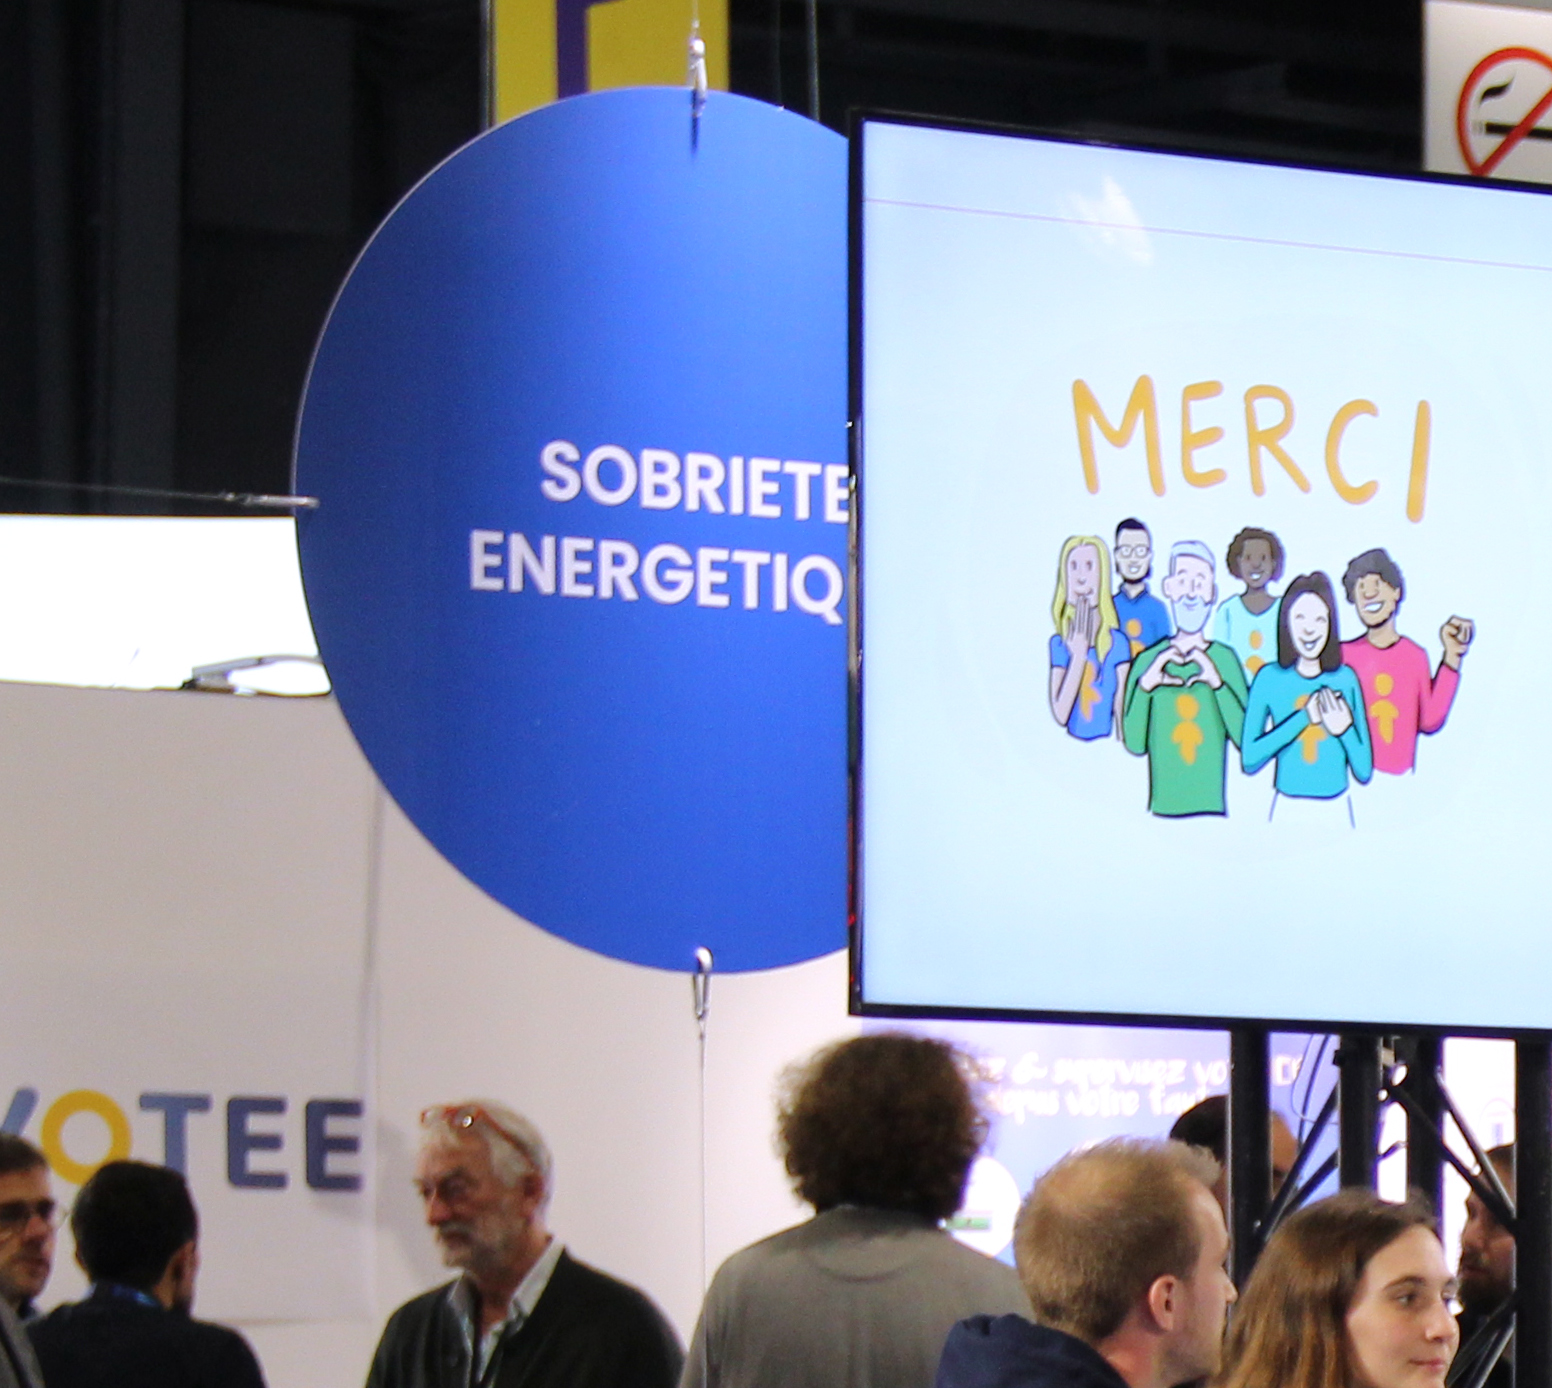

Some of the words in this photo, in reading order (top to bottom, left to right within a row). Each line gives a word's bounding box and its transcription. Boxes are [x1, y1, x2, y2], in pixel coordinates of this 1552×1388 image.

[540, 439, 849, 525] SOBRIETE
[1072, 374, 1431, 523] MERCI
[469, 529, 844, 625] ENERGETIQ
